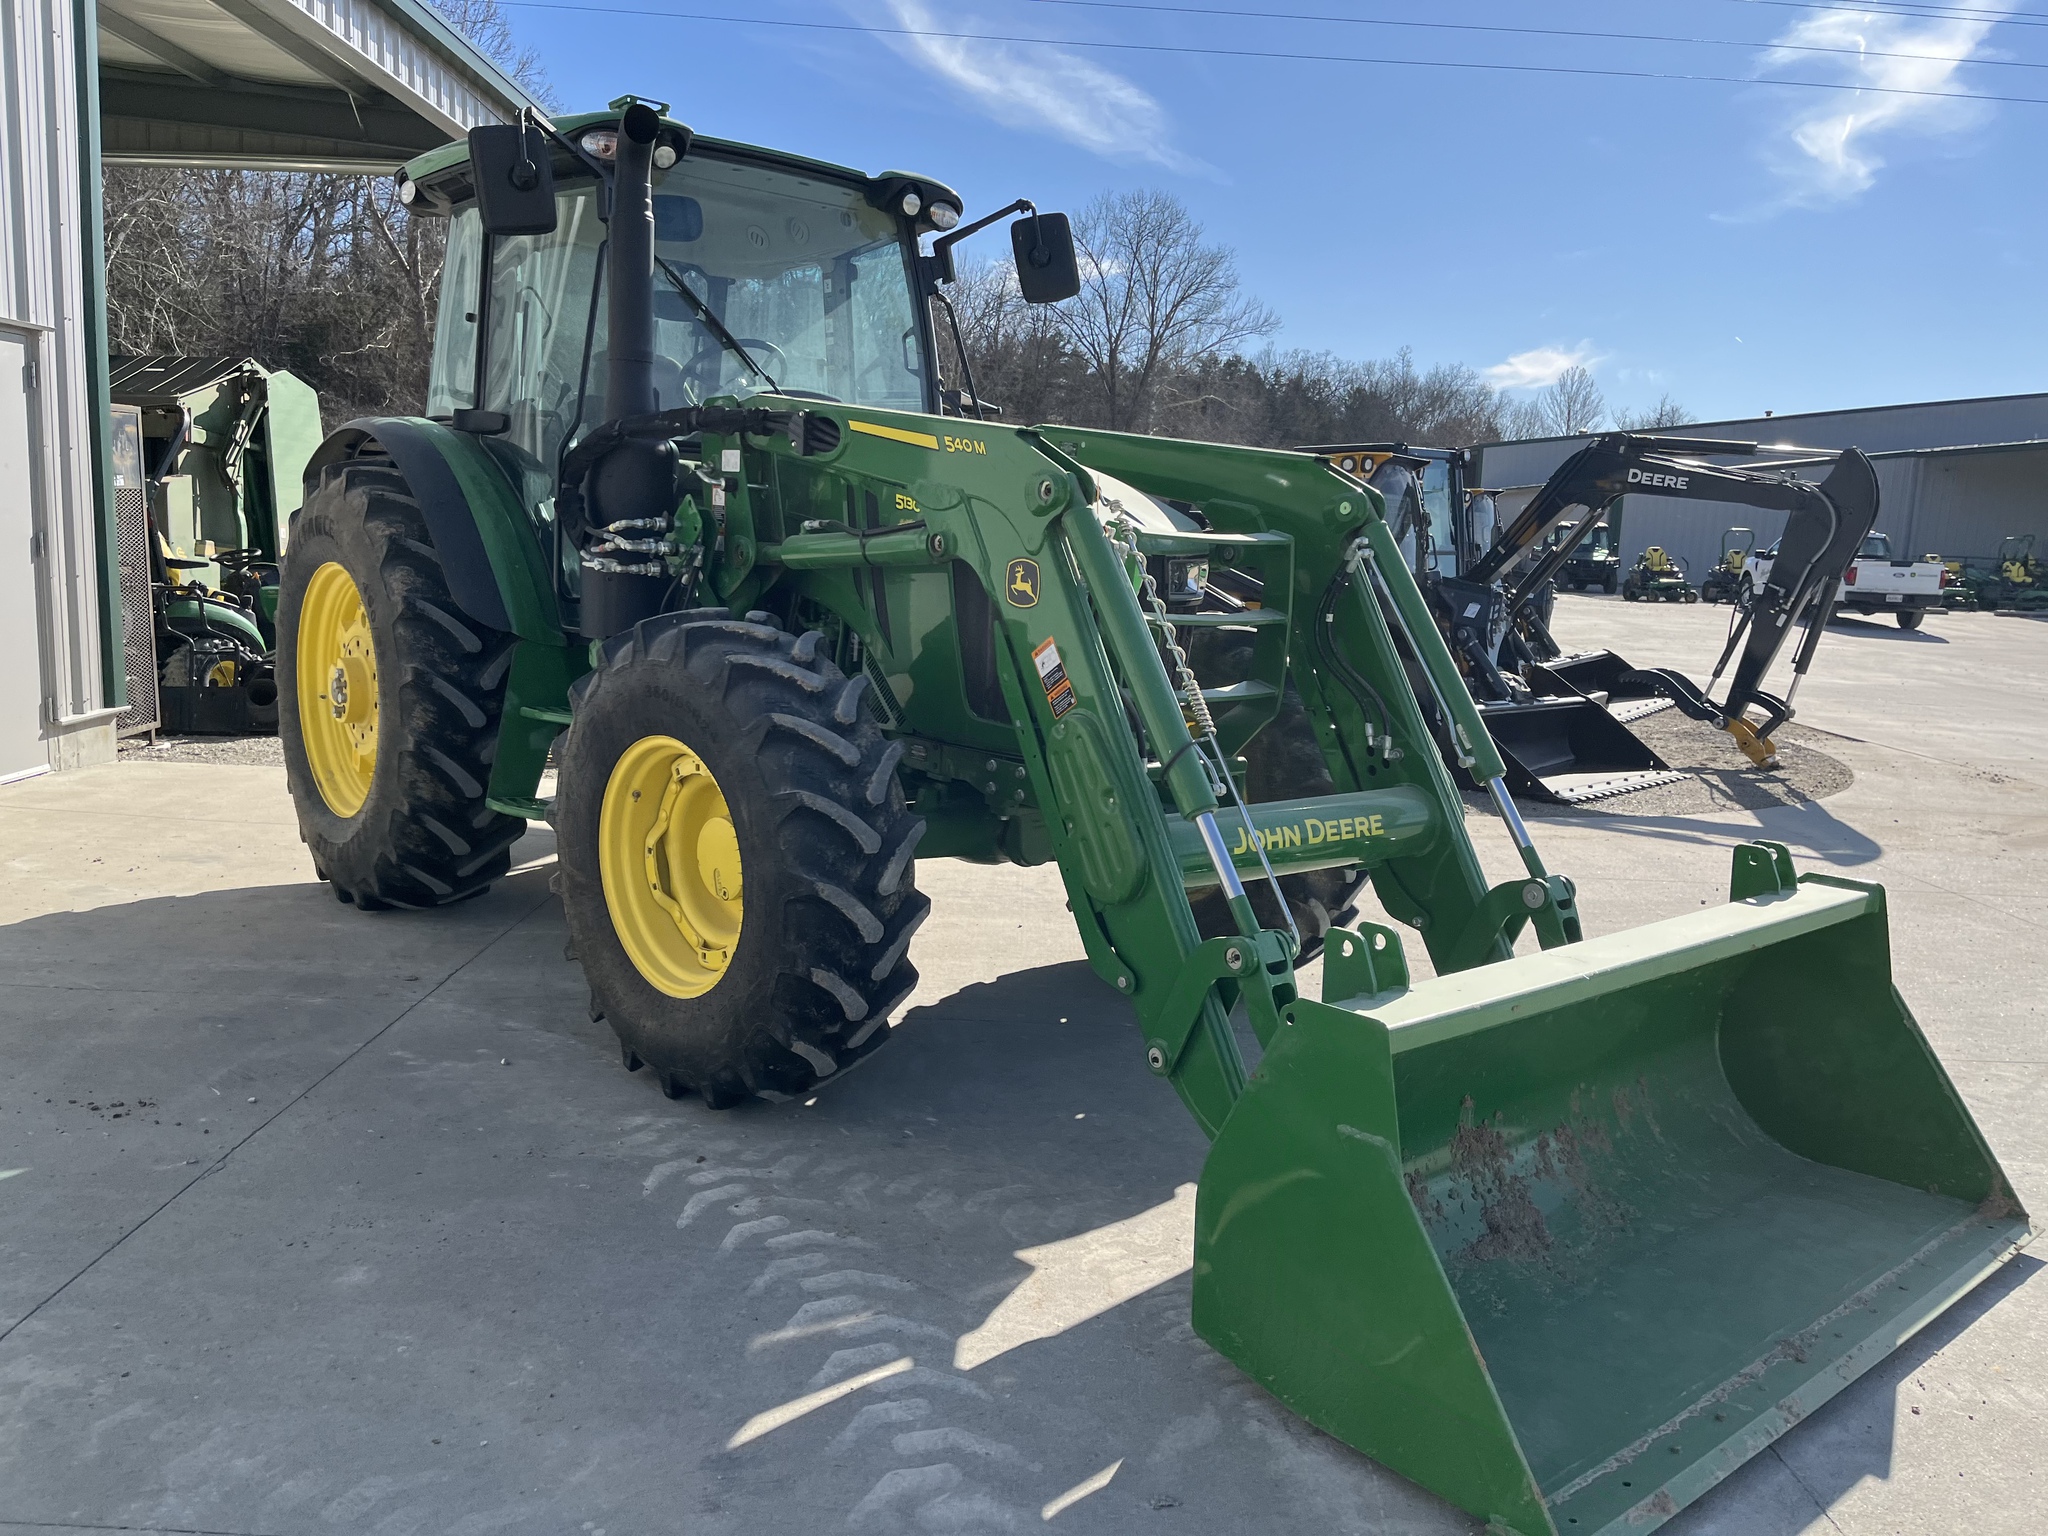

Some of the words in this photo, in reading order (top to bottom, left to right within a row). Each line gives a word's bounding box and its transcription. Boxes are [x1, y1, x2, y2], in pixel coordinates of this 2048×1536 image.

[1627, 468, 1689, 490] DEERE
[1233, 824, 1302, 855] JOHN
[1304, 814, 1385, 845] DEERE
